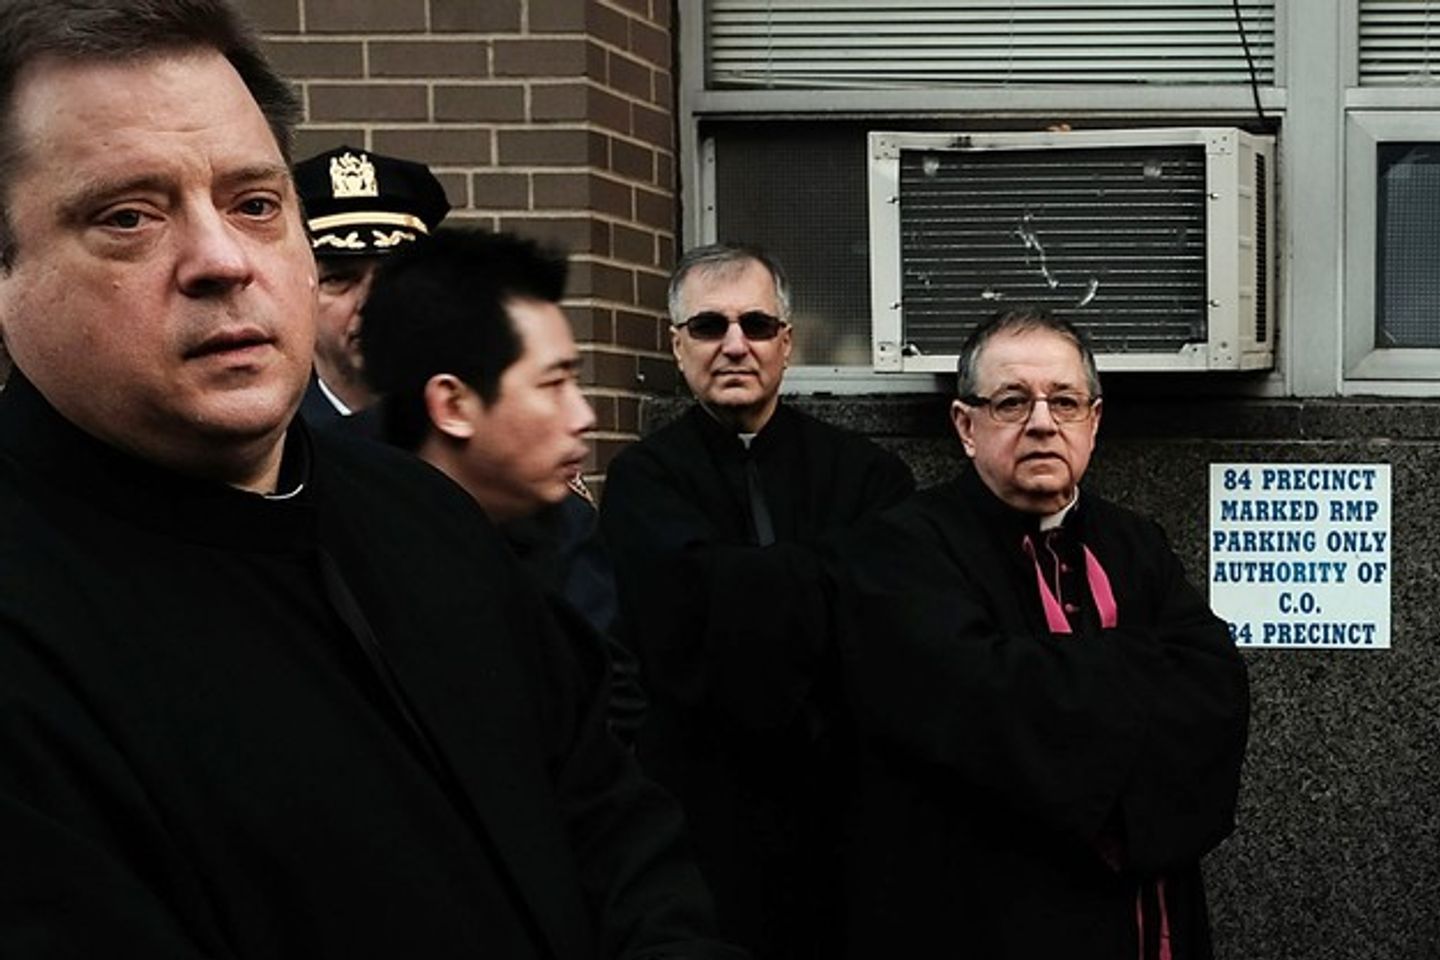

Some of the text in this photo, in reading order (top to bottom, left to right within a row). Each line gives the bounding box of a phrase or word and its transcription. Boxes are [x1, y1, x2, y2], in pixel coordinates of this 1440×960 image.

[1223, 469, 1376, 490] 84 PRECINCT
[1220, 500, 1379, 522] MARKED RMP
[1212, 531, 1387, 552] PARKING ONLY
[1213, 562, 1387, 583] AUTHORITY OF
[1279, 592, 1322, 614] C.O.
[1262, 623, 1376, 644] PRECINCT
